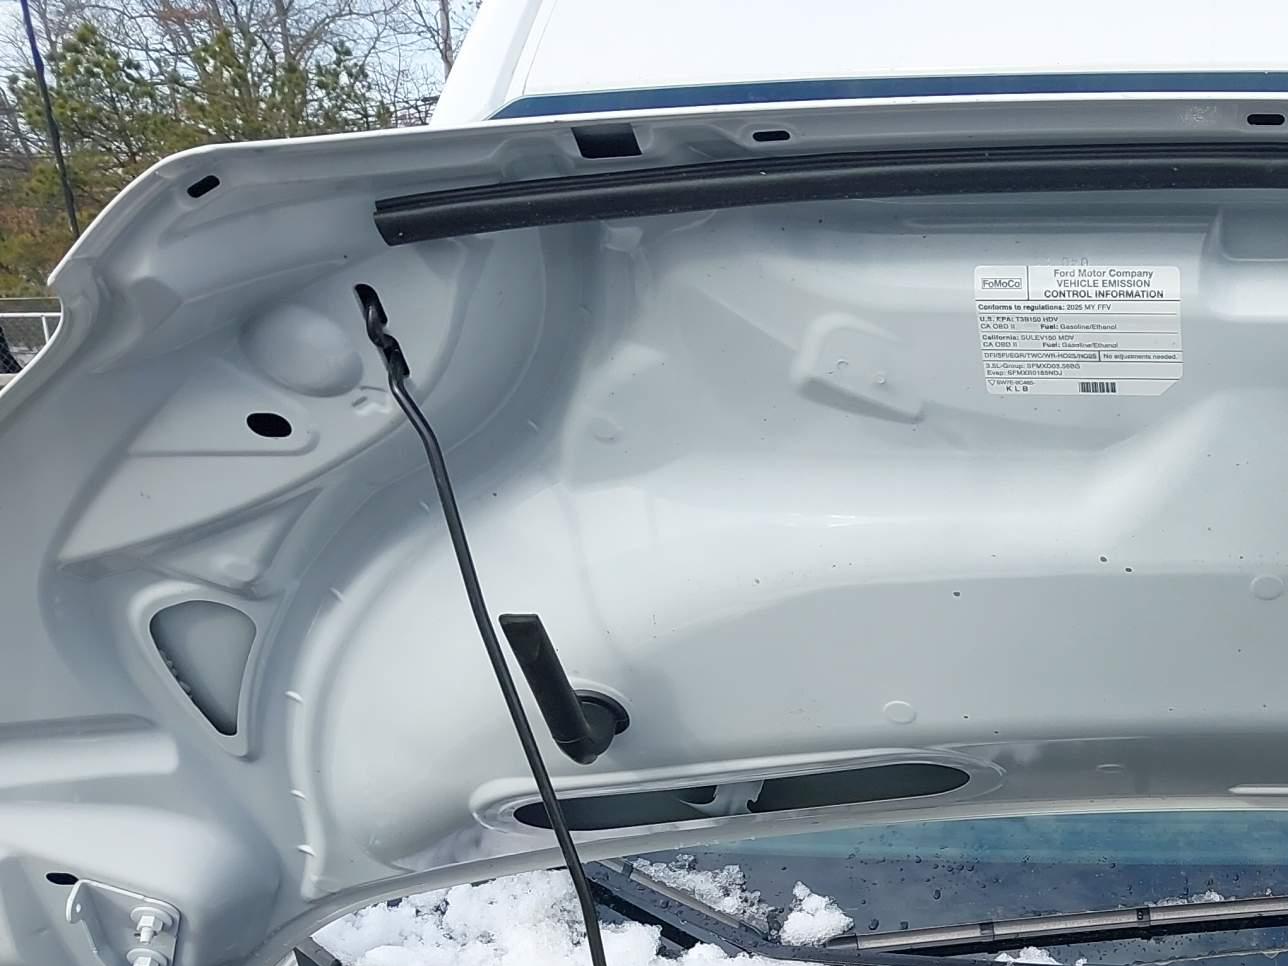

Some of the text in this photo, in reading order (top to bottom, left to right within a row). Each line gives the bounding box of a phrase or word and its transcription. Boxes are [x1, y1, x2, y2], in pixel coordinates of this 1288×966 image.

[1054, 269, 1154, 280] Ford Motor Company
[983, 279, 1021, 289] FoMoCo
[1057, 279, 1151, 288] VEHICLE EMISSION
[1044, 290, 1164, 299] CONTROL INFORMATION
[978, 303, 1012, 311] Conforms
[1023, 304, 1066, 313] regulations:
[1060, 323, 1117, 331] Gasoline/Ethanol
[1061, 342, 1119, 350] Gasoline/Ethanol
